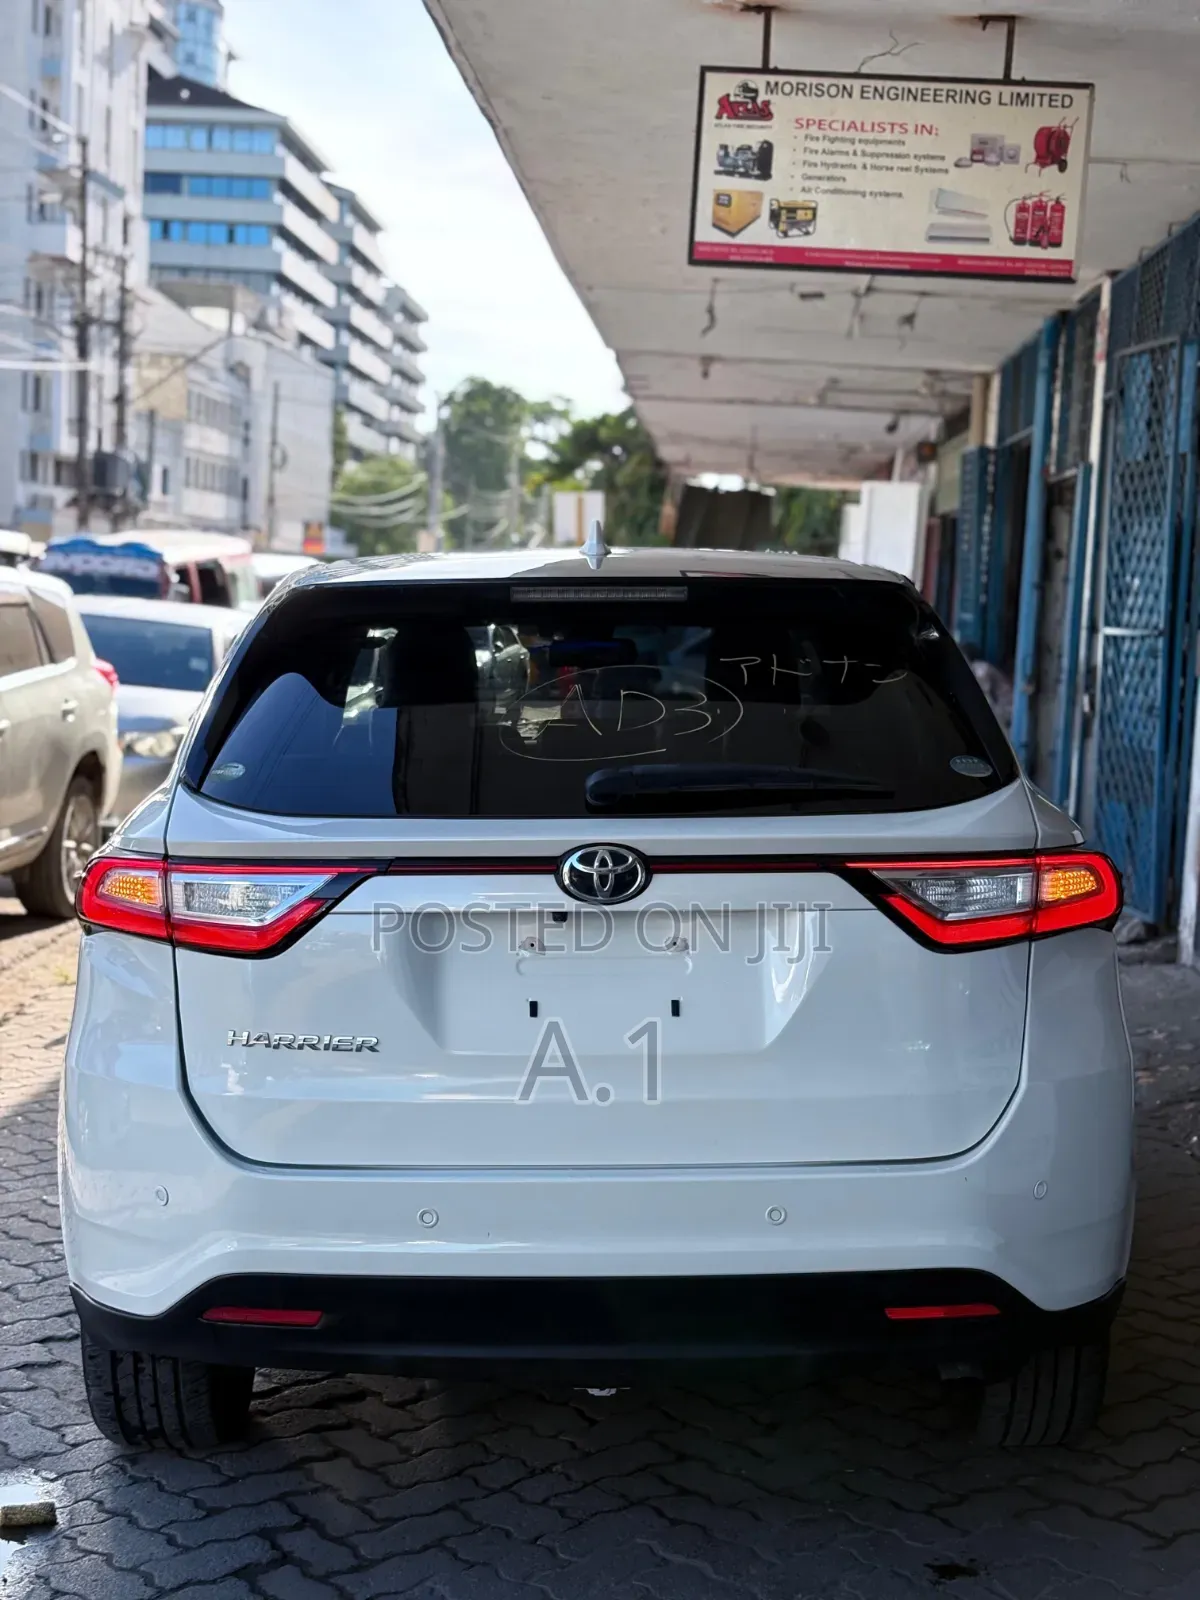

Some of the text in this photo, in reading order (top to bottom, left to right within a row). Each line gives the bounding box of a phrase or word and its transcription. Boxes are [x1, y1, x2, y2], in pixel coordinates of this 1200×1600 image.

[765, 80, 1074, 109] MORISON ENGINEERING LIMITED
[794, 118, 940, 137] SPECIALISTS IN:
[804, 133, 906, 147] Fire Fighting equipments
[803, 146, 946, 163] Fire Alarms & Suppression systems
[802, 160, 818, 169] Fire
[820, 161, 857, 172] Hydrants
[861, 162, 868, 171] &
[801, 173, 847, 184] Generators
[801, 186, 813, 195] Air
[814, 187, 867, 199] Conditioning
[226, 1029, 381, 1054] HARRIER
